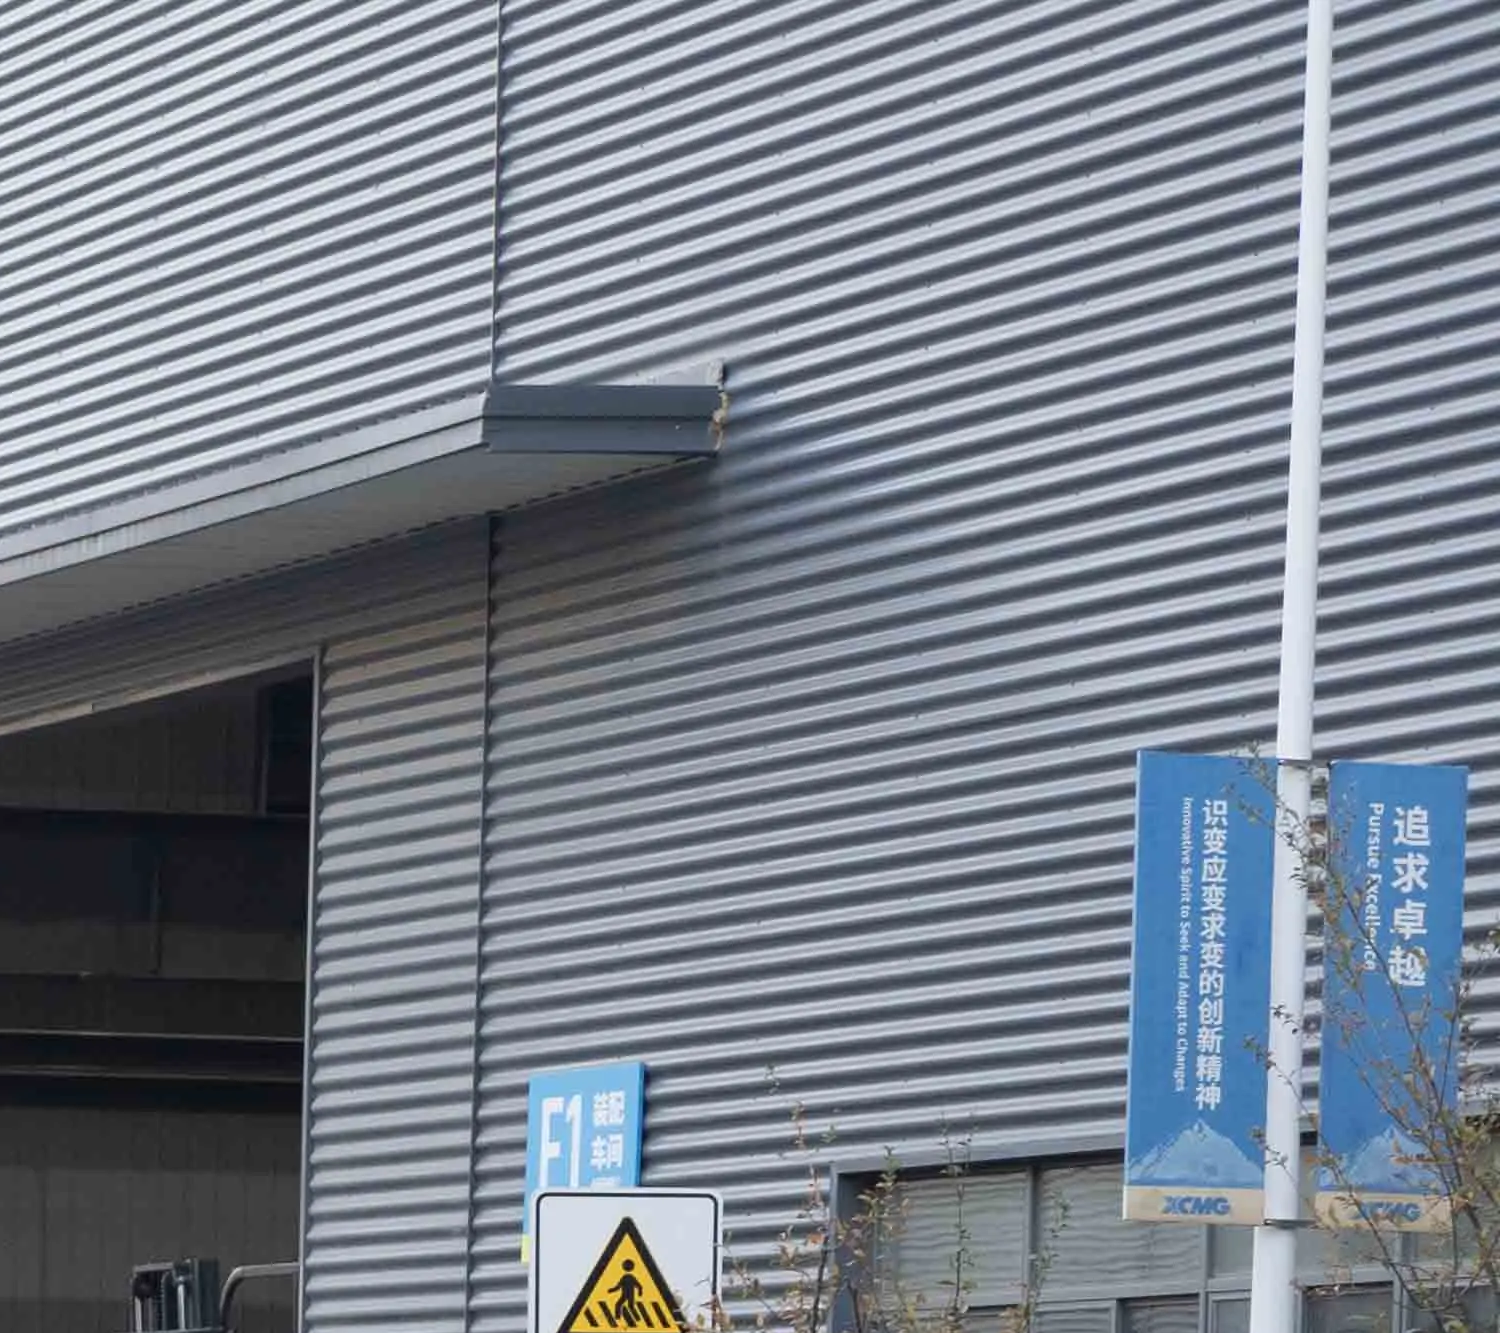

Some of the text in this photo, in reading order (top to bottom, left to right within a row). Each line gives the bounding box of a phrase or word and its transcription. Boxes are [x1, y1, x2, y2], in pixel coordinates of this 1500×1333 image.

[1366, 803, 1385, 869] Pursue
[1387, 805, 1431, 987] 追求卓越
[1172, 797, 1195, 1092] Innovative Spirit to Seek and Adapt to Changes
[1194, 799, 1229, 1111] 识变应变求变的创新精神
[1162, 1196, 1231, 1215] XCMG
